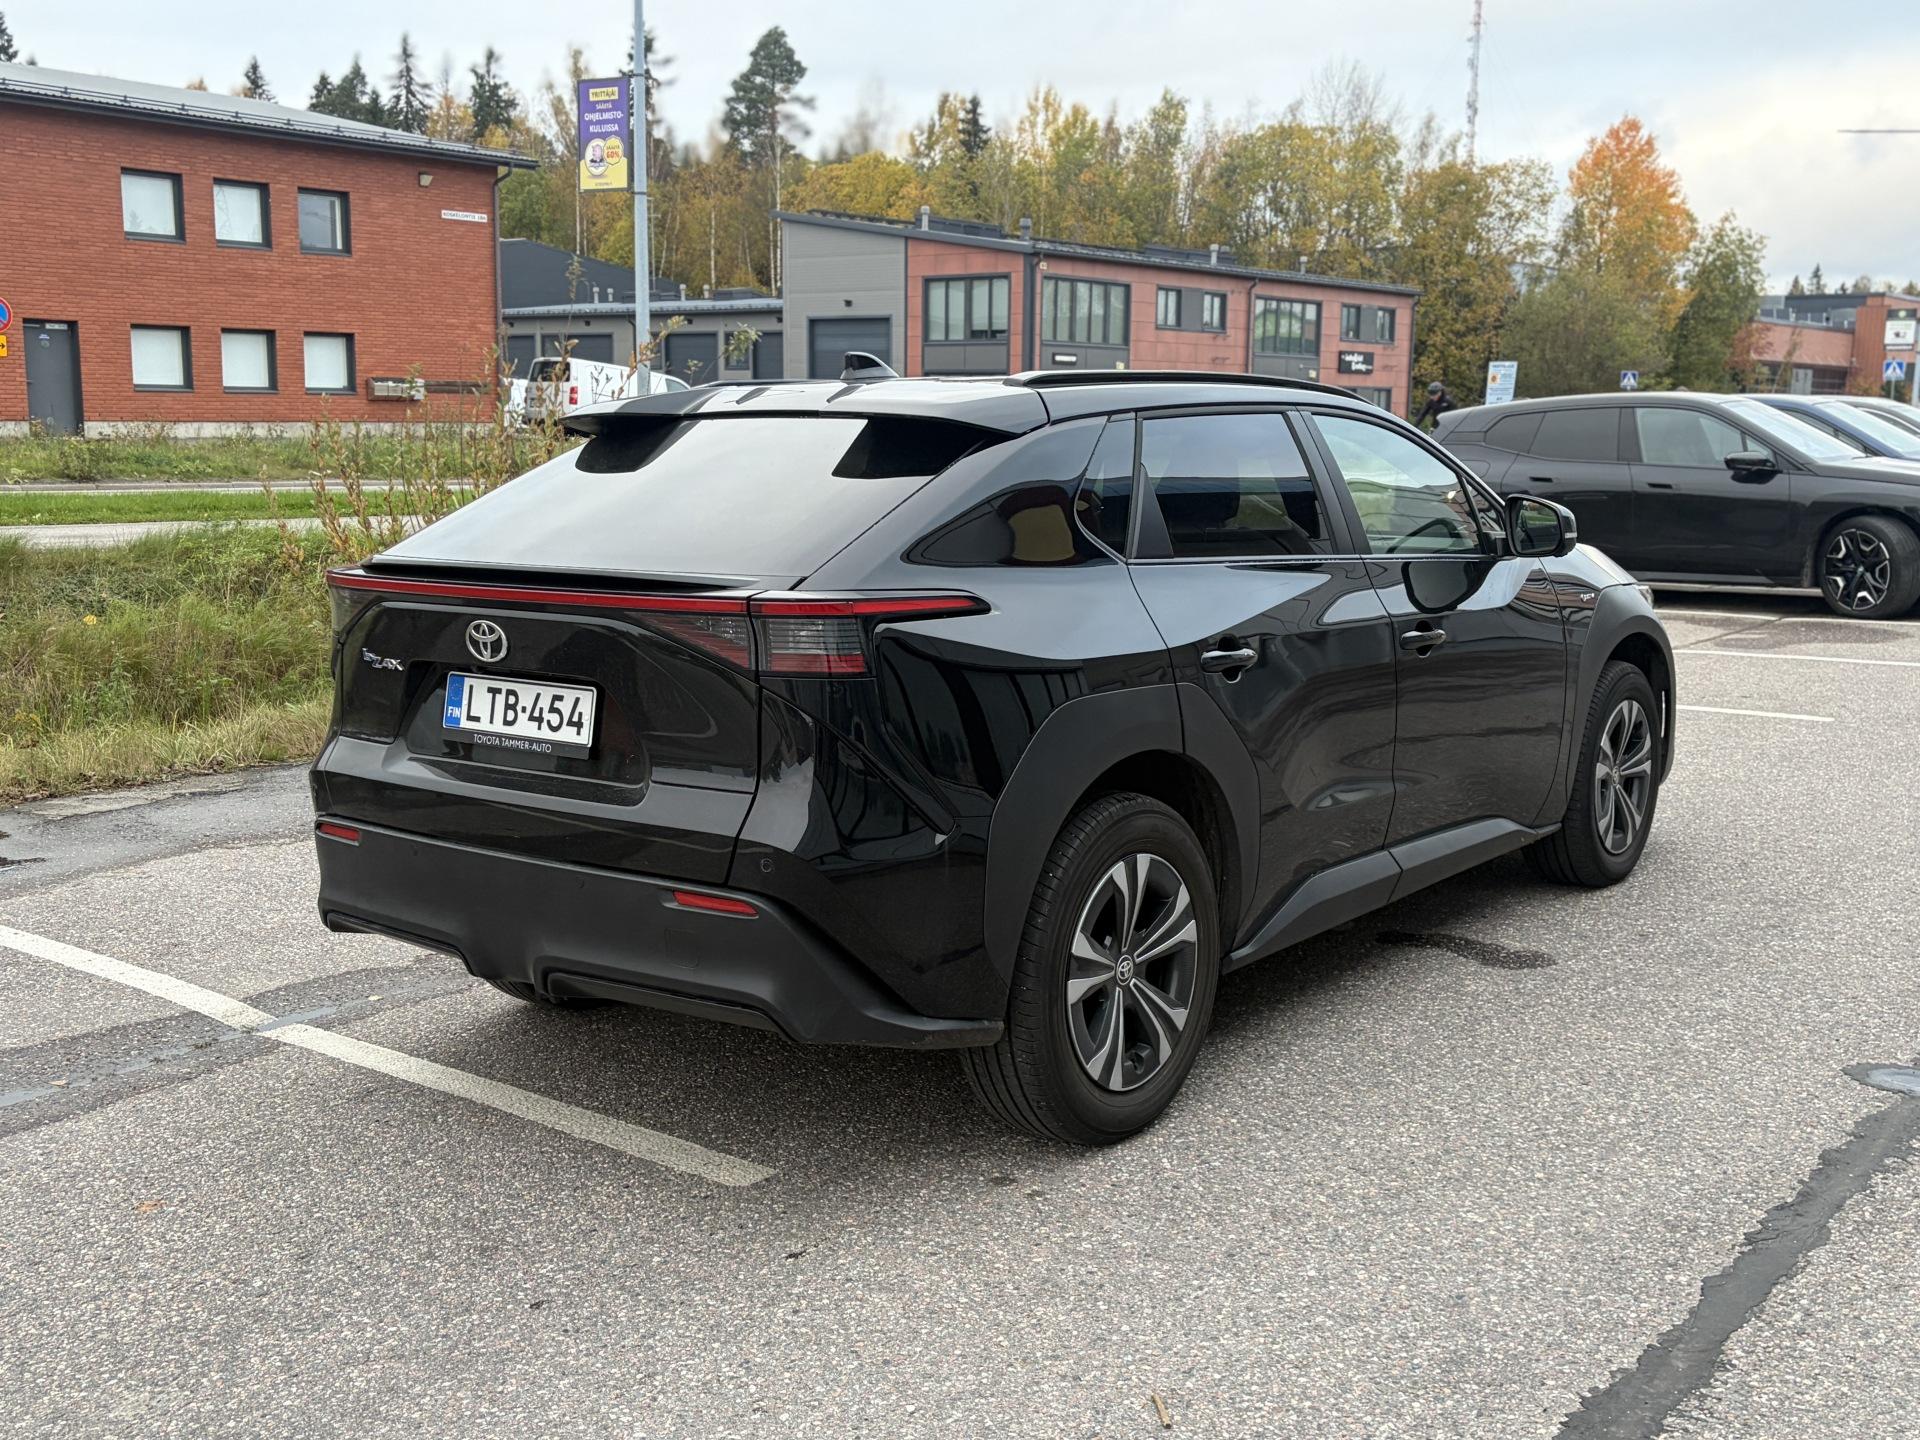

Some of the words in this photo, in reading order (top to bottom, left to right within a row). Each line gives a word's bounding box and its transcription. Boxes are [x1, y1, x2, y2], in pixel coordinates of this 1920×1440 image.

[584, 111, 624, 122] OHJELMISTO-
[589, 124, 619, 132] KULUISSA
[447, 706, 461, 718] FIN
[473, 733, 500, 746] TOYOTA
[501, 737, 552, 753] TAMMER-AUTO
